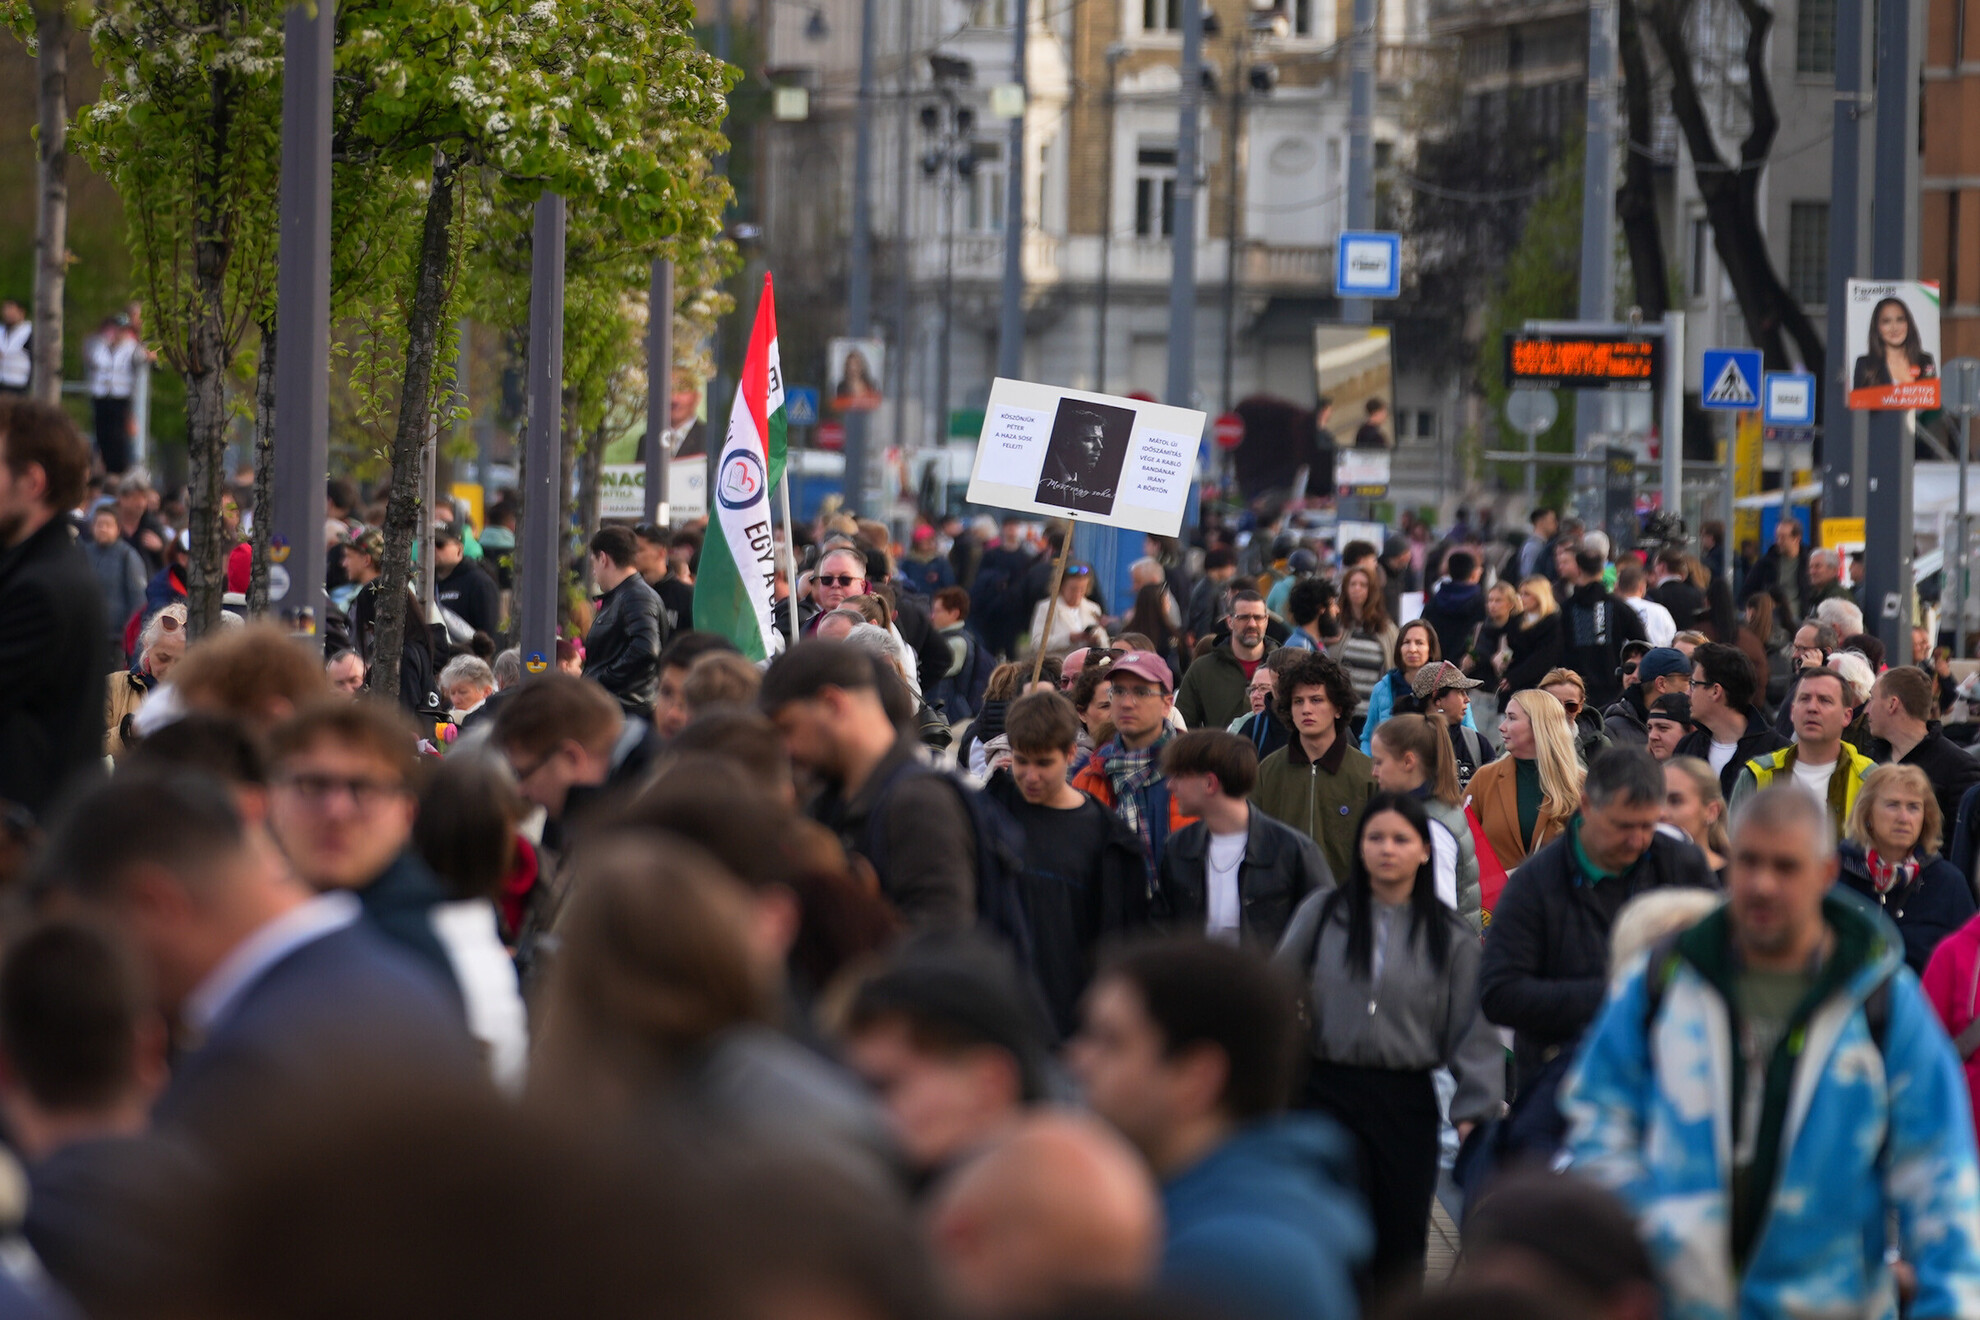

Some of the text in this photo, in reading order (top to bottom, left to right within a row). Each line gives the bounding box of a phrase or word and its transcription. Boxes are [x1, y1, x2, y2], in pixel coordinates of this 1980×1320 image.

[1007, 423, 1024, 431] PÉTER
[1002, 442, 1023, 450] FELEJTI
[1140, 454, 1154, 462] VÉGE
[1142, 465, 1175, 476] BANDÁNAK
[743, 520, 775, 563] EGY
